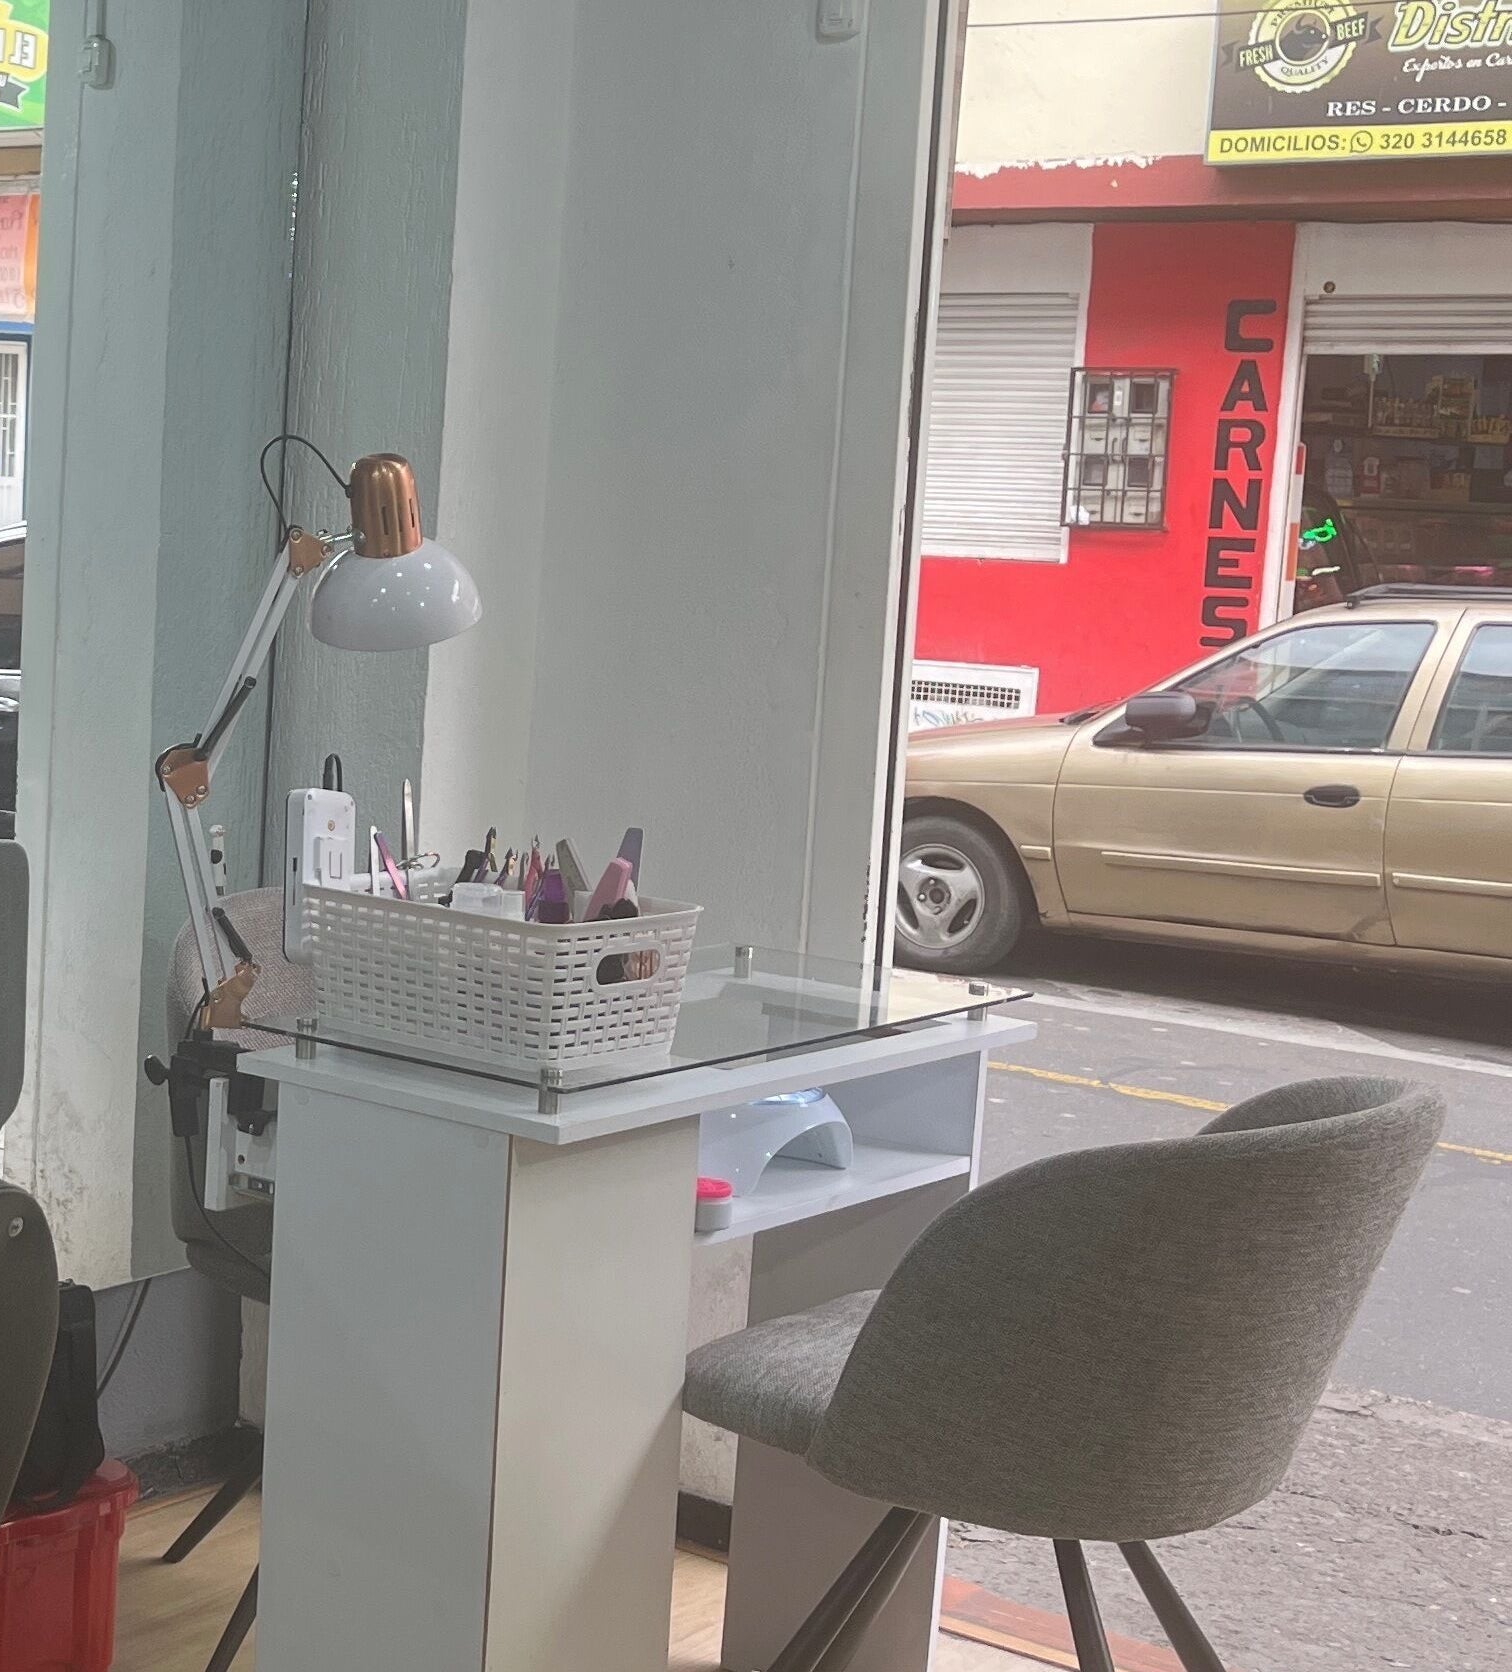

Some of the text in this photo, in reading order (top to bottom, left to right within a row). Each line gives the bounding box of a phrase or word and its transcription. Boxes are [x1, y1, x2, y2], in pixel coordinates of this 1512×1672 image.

[1336, 17, 1366, 41] BEEF
[1239, 44, 1274, 68] FRESH
[1280, 56, 1329, 77] QUALITY
[1402, 55, 1463, 82] Expertos
[1326, 100, 1377, 117] RES
[1397, 95, 1492, 114] CERDO
[1220, 129, 1507, 153] DOMICILIOS: 320 3144658
[1199, 299, 1277, 650] CARNES
